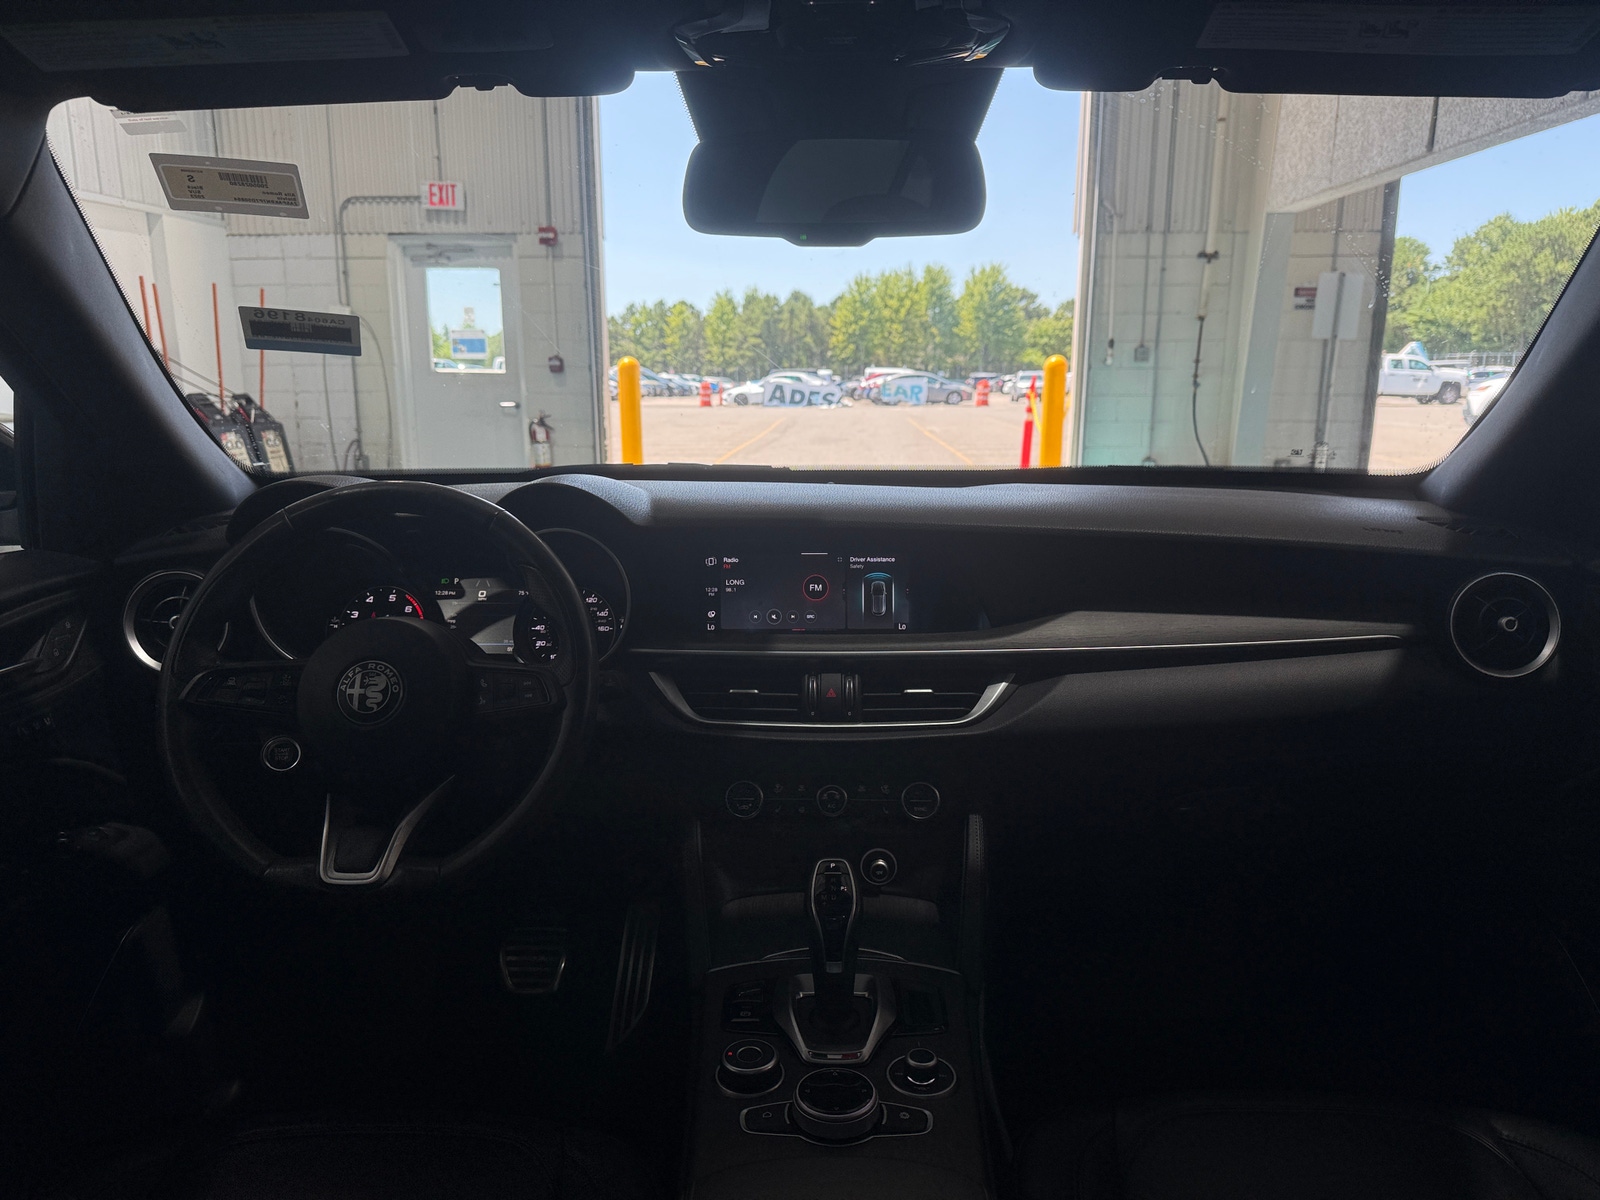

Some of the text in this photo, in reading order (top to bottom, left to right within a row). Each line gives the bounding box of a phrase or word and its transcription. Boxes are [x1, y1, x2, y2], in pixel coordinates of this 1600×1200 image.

[428, 183, 457, 207] EXIT
[768, 384, 843, 406] ADES
[809, 584, 823, 592] FM
[388, 594, 397, 602] 5
[404, 605, 413, 613] 6
[898, 622, 907, 630] Lo
[340, 662, 400, 693] ALFA ROMEO
